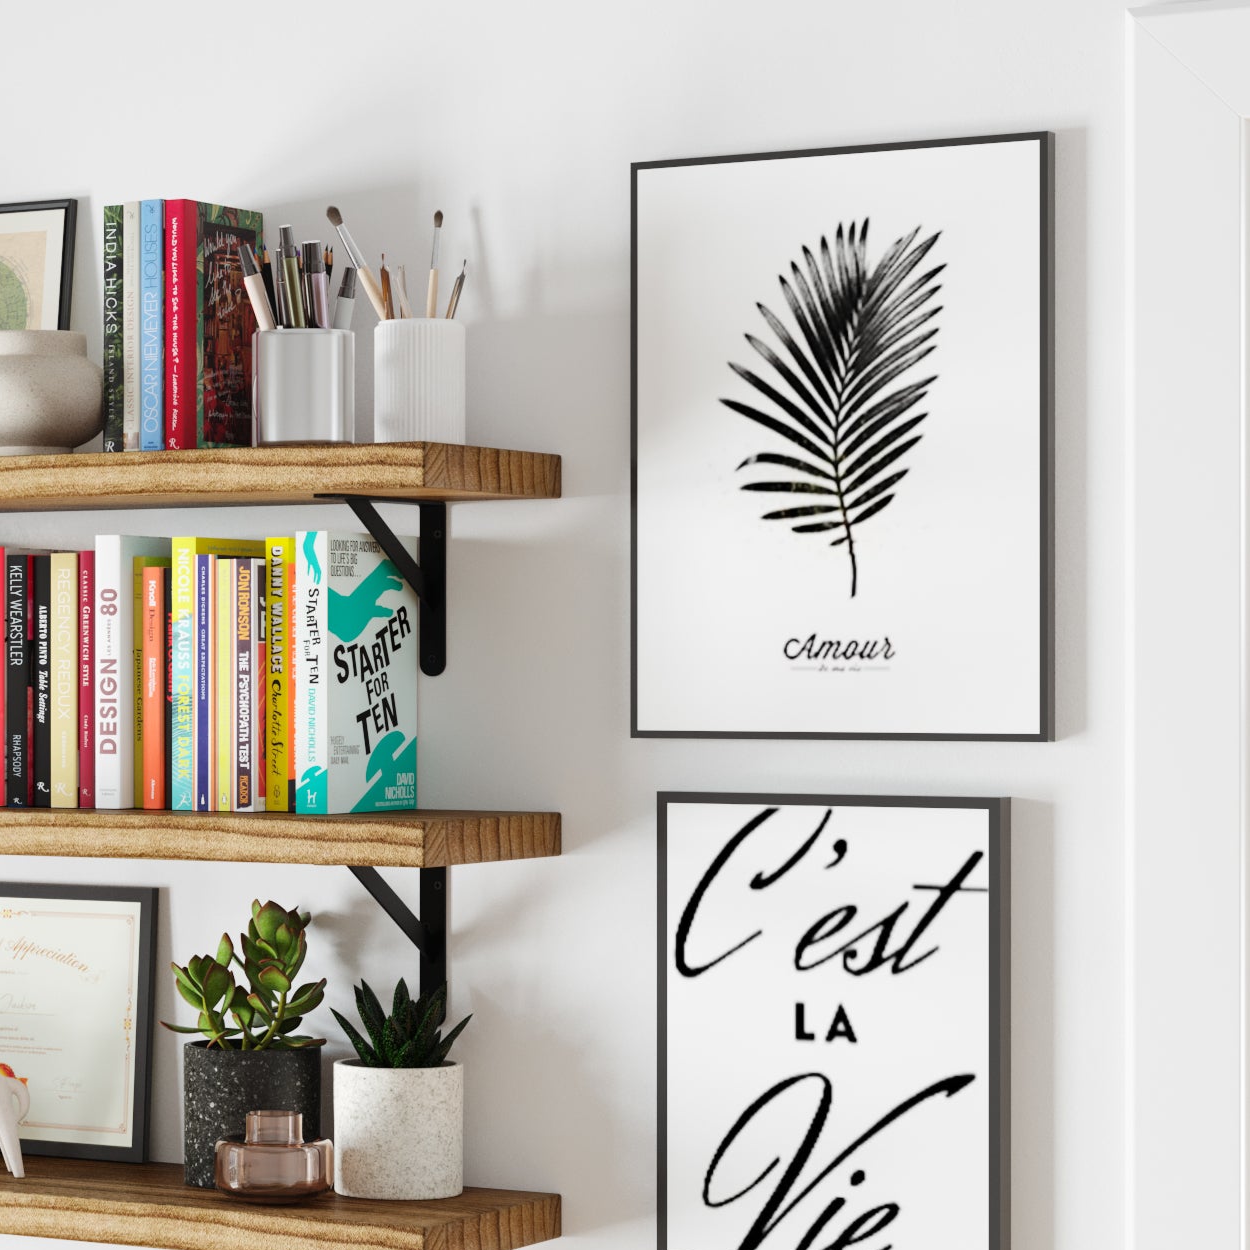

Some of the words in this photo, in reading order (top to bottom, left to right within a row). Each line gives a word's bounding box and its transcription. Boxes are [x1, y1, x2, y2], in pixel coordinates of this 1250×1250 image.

[105, 222, 117, 272] INDIA
[144, 224, 158, 288] HOUSES
[105, 278, 117, 334] HICKS
[144, 291, 158, 371] NIEMEYER
[145, 374, 158, 432] OSCAR
[9, 565, 22, 596] KELLY
[177, 548, 190, 603] NICOLE
[238, 566, 251, 590] JON
[271, 545, 283, 597] DANNY
[57, 568, 71, 655] REGENCY
[100, 588, 118, 616] 80
[148, 580, 157, 607] Knoll
[9, 599, 22, 665] WEARSTLER
[39, 605, 47, 639] ALBERTO
[238, 592, 251, 641] RONSON
[271, 601, 283, 674] WALLACE
[305, 588, 322, 646] STARTER
[39, 641, 47, 665] PINTO
[177, 609, 190, 670] KRAUSS
[303, 639, 311, 656] FOR
[333, 605, 411, 684] STARTER
[783, 634, 895, 661] Amour
[38, 670, 48, 691] Table
[238, 651, 250, 672] THE
[305, 655, 320, 685] TEN
[37, 692, 48, 723] Settings
[57, 663, 71, 720] REDUX
[100, 658, 118, 755] DESIGN
[177, 675, 190, 731] FOREST
[238, 674, 250, 742] PSYCHOPATH
[271, 679, 285, 736] Charlotte
[308, 688, 316, 715] DAVID
[365, 671, 389, 705] FOR
[307, 718, 316, 762] NICHOLLS
[356, 692, 399, 755] TEN
[12, 734, 22, 777] RHAPSODY
[177, 736, 190, 780] DARK
[238, 743, 250, 770] TEST
[271, 737, 285, 776] Street
[239, 775, 248, 804] PICADOR
[385, 785, 415, 800] NICHOLLS
[396, 772, 415, 786] DAVID
[5, 936, 89, 973] Appreciation
[795, 1002, 857, 1042] LA
